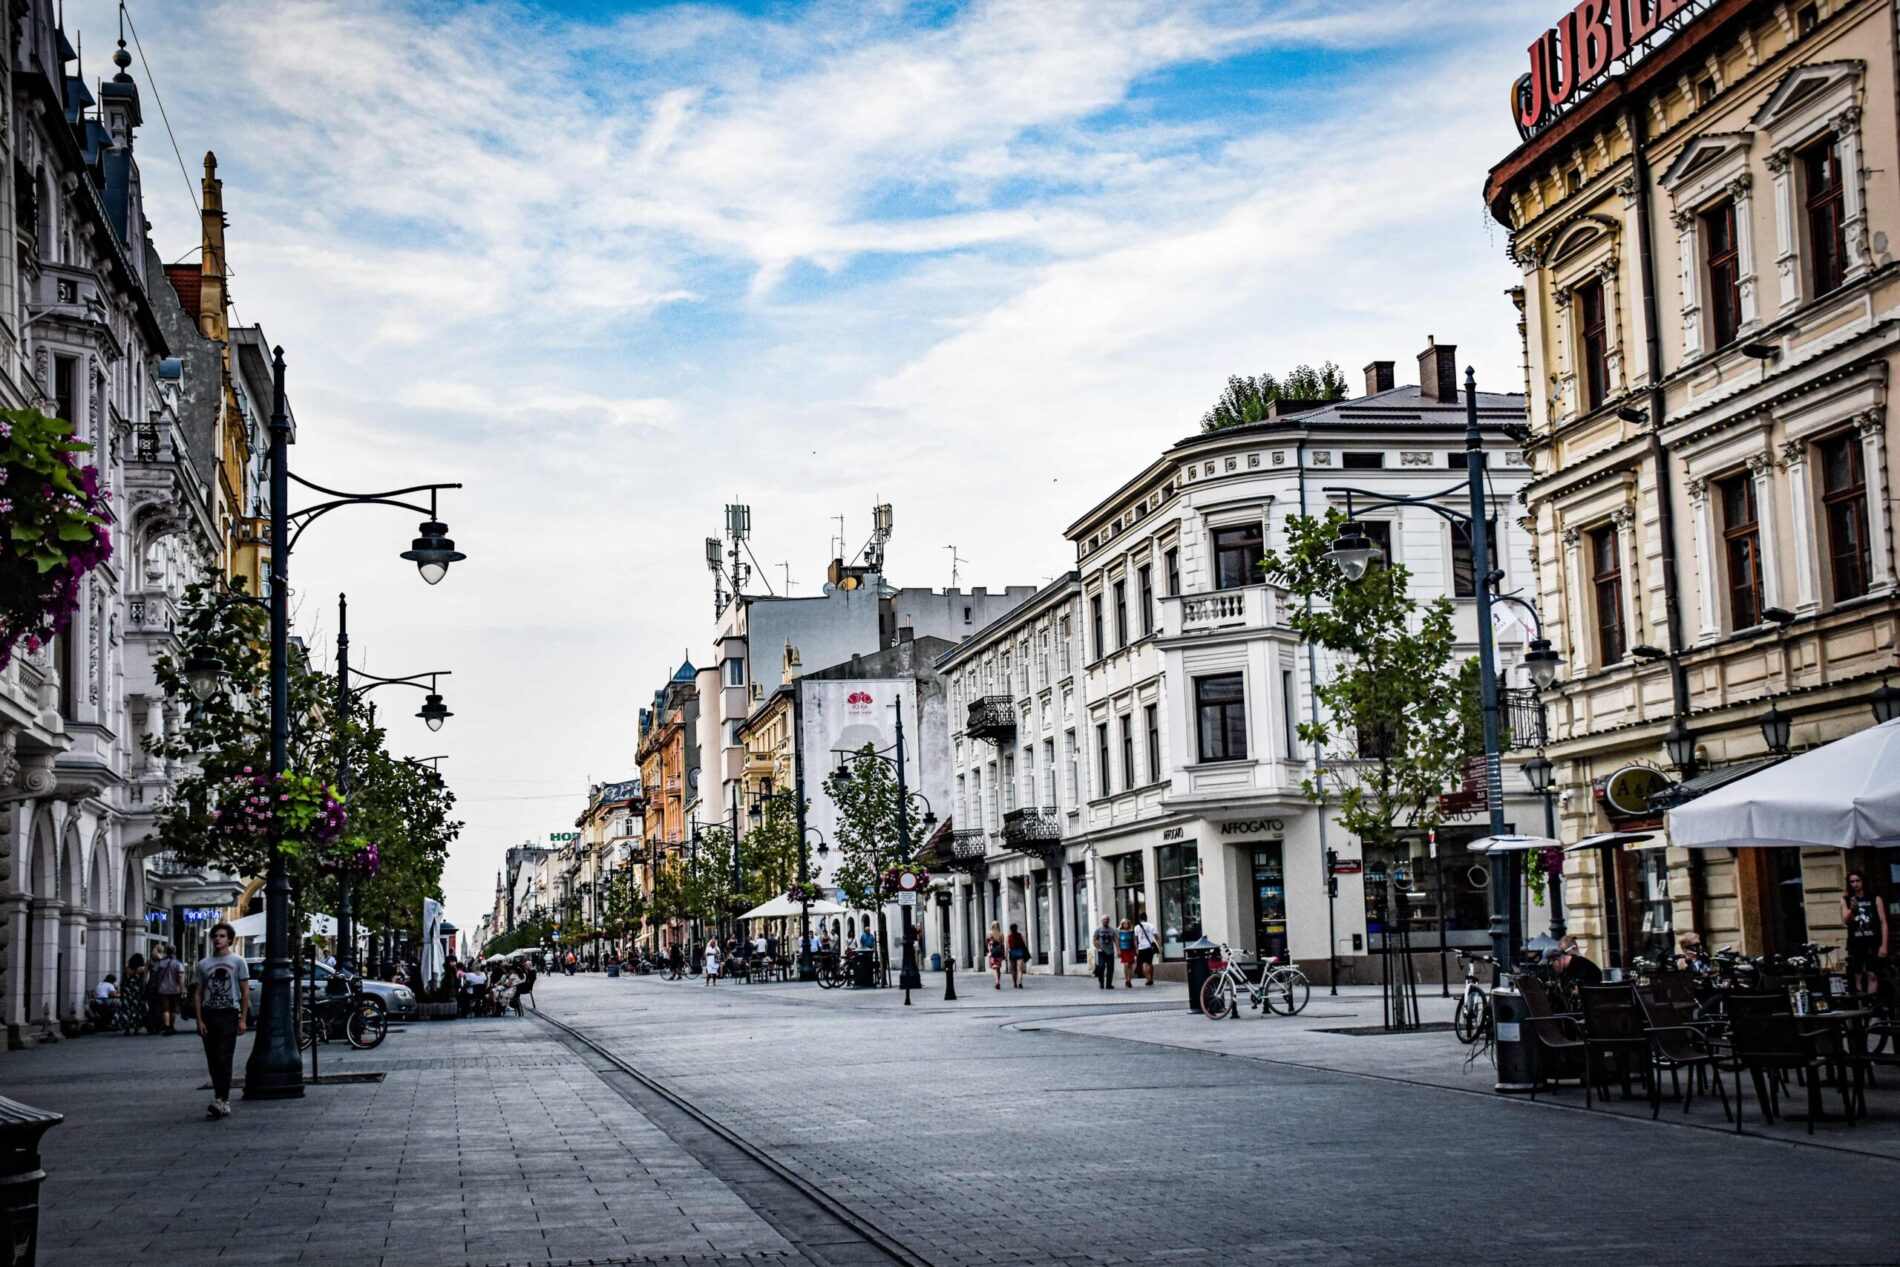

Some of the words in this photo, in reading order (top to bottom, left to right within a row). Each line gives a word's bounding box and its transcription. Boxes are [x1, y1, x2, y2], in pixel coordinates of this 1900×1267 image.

[1521, 0, 1689, 127] JUBIL
[1163, 827, 1184, 841] AFFOGATO
[1221, 819, 1284, 835] AFFOGATO
